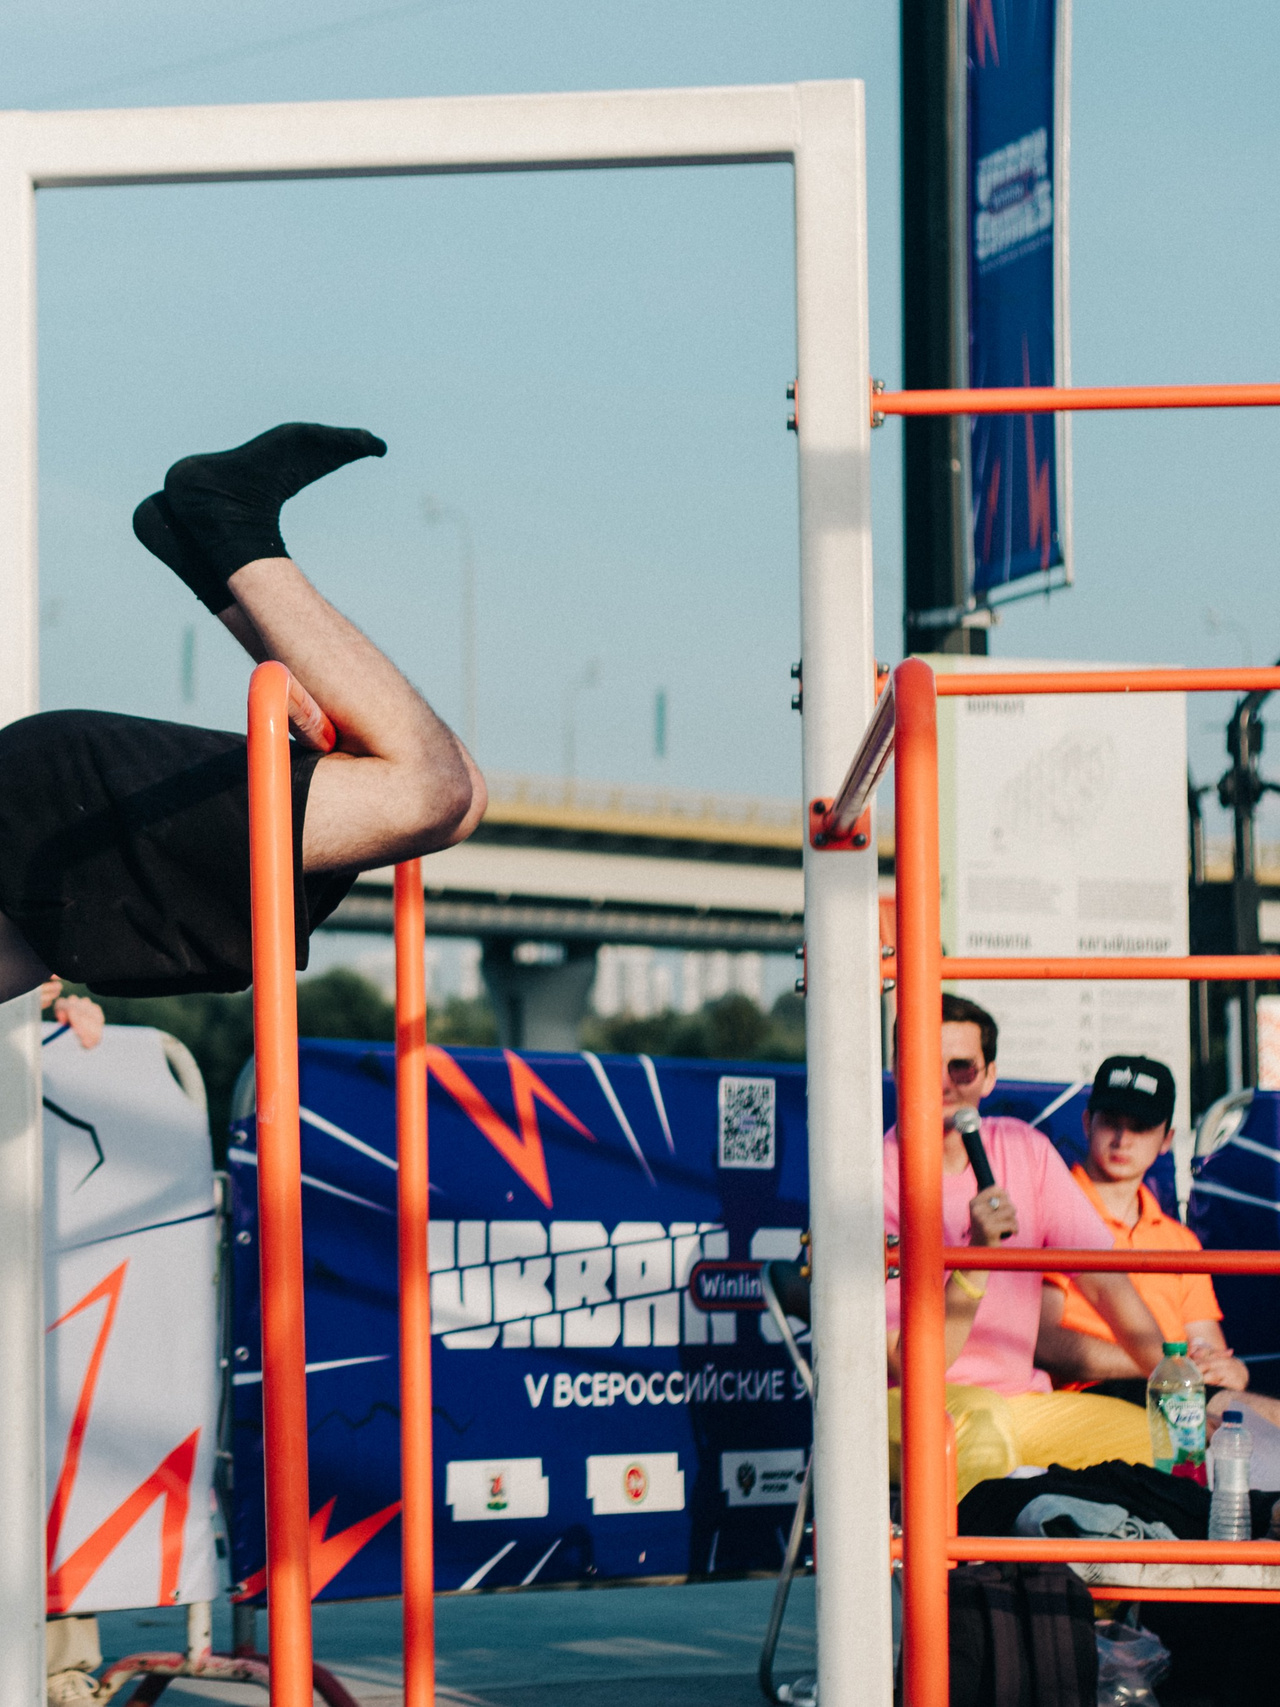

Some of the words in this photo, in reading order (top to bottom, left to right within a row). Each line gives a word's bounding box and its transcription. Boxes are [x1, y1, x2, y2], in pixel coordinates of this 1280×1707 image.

[699, 1272, 763, 1298] Winlin
[523, 1373, 549, 1409] V
[552, 1363, 786, 1408] ВСЕРОССИЙСКИЕ
